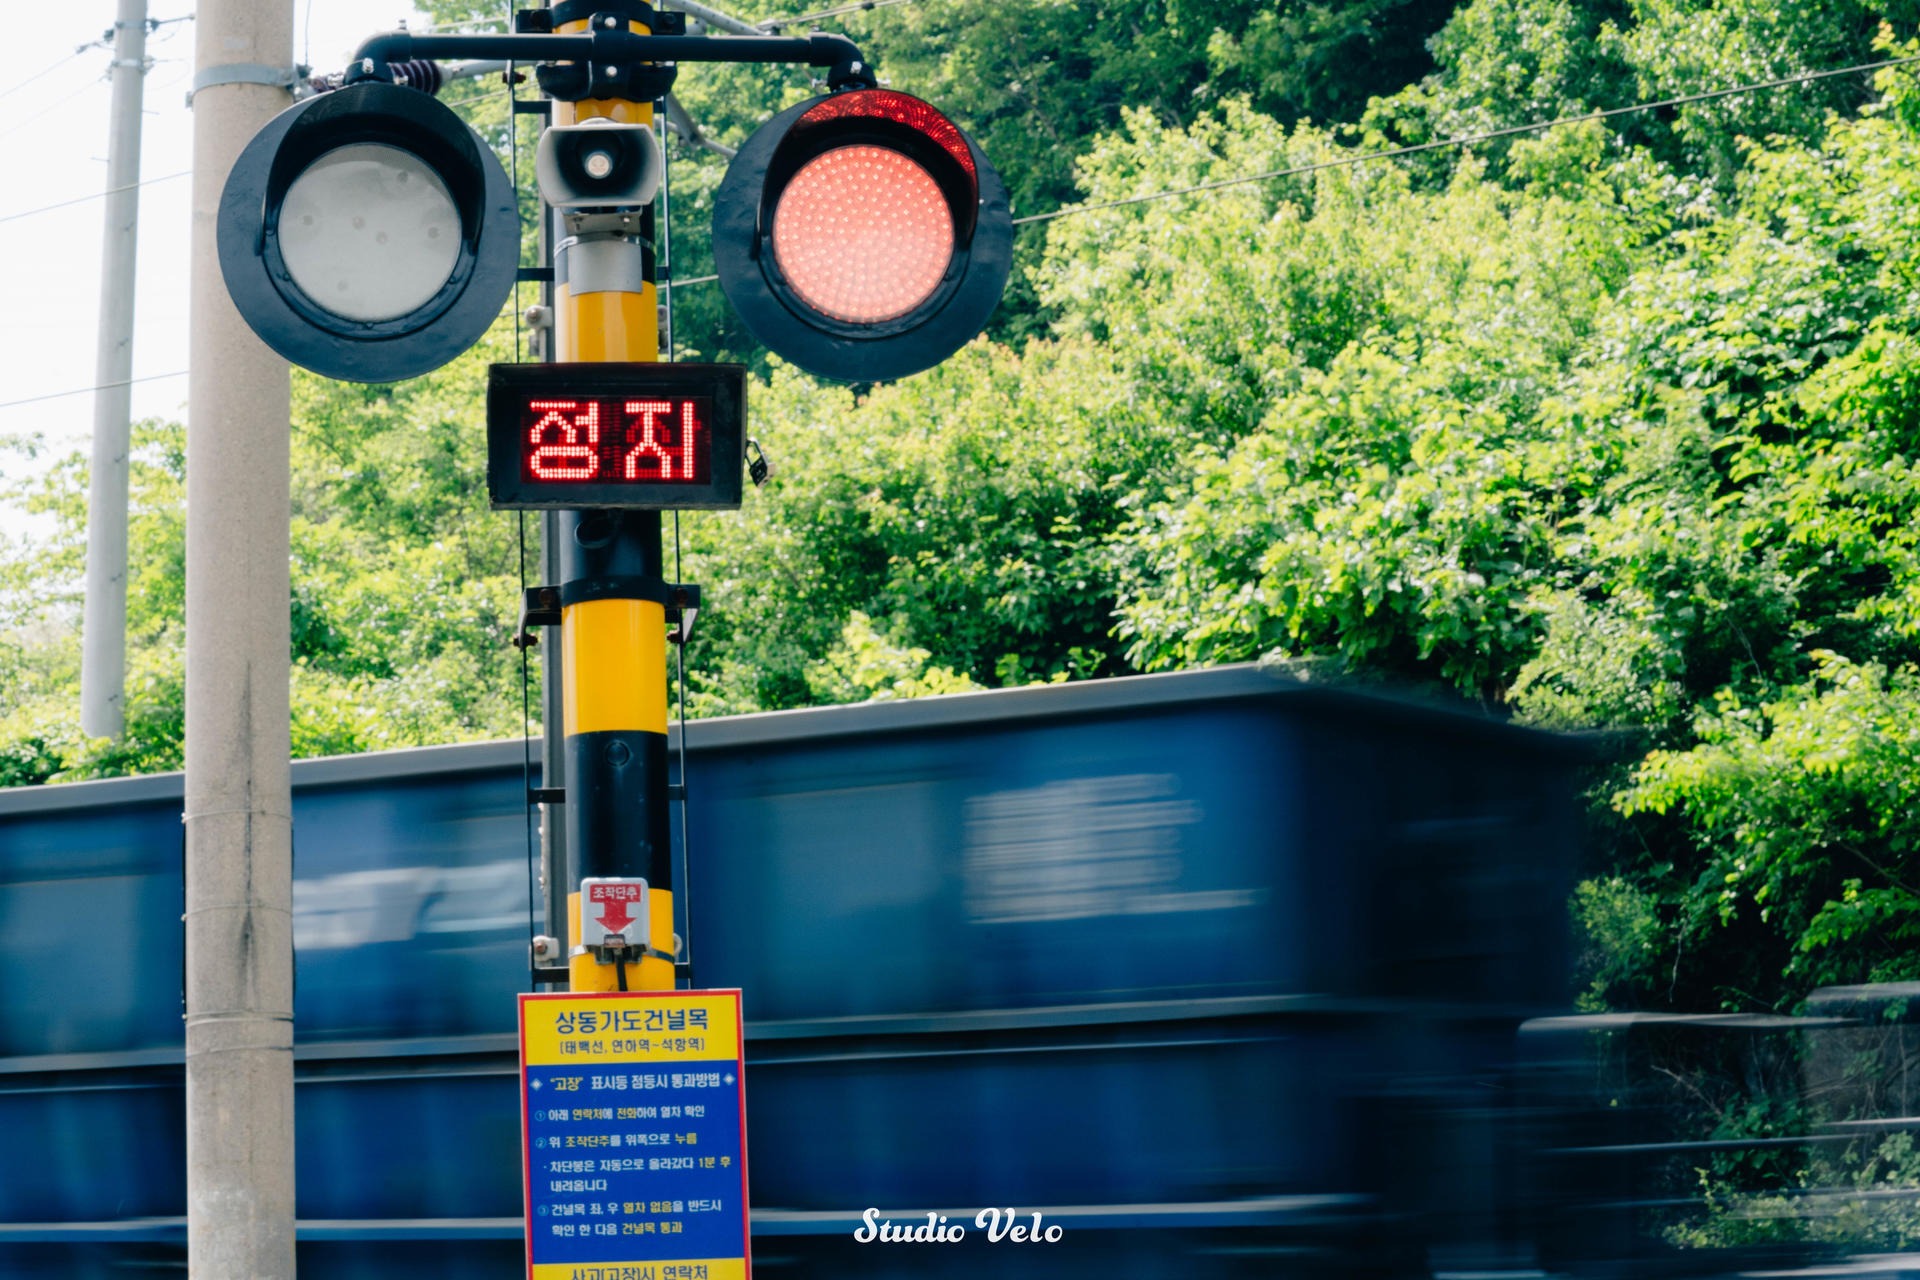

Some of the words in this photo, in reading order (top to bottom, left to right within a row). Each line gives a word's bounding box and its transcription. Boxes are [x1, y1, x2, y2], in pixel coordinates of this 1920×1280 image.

[530, 400, 695, 479] 정지
[555, 1008, 709, 1034] 상동가도건널목
[591, 1075, 628, 1090] 표시등
[631, 1074, 668, 1089] 점등시
[672, 1073, 721, 1088] 통과방법
[548, 1110, 569, 1121] 아래
[617, 1107, 657, 1119] 전화하여
[661, 1106, 681, 1117] 열차
[684, 1105, 705, 1117] 확인
[549, 1136, 561, 1148] 위
[565, 1134, 621, 1148] 조작단추를
[625, 1133, 671, 1146] 위쪽으로
[675, 1132, 697, 1145] 누름
[550, 1160, 595, 1173] 차단봉은
[600, 1159, 644, 1171] 자동으로
[649, 1157, 694, 1170] 올라갔다
[699, 1157, 715, 1169] 1분
[720, 1156, 731, 1168] 후
[552, 1204, 585, 1217] 건널목
[608, 1202, 619, 1214] 우
[623, 1202, 646, 1214] 열차
[650, 1201, 684, 1214] 없음을
[688, 1199, 722, 1212] 반드시
[552, 1224, 575, 1237] 확인
[579, 1223, 591, 1237] 한
[595, 1223, 618, 1236] 다음
[622, 1222, 655, 1235] 건널목
[660, 1221, 683, 1234] 통과
